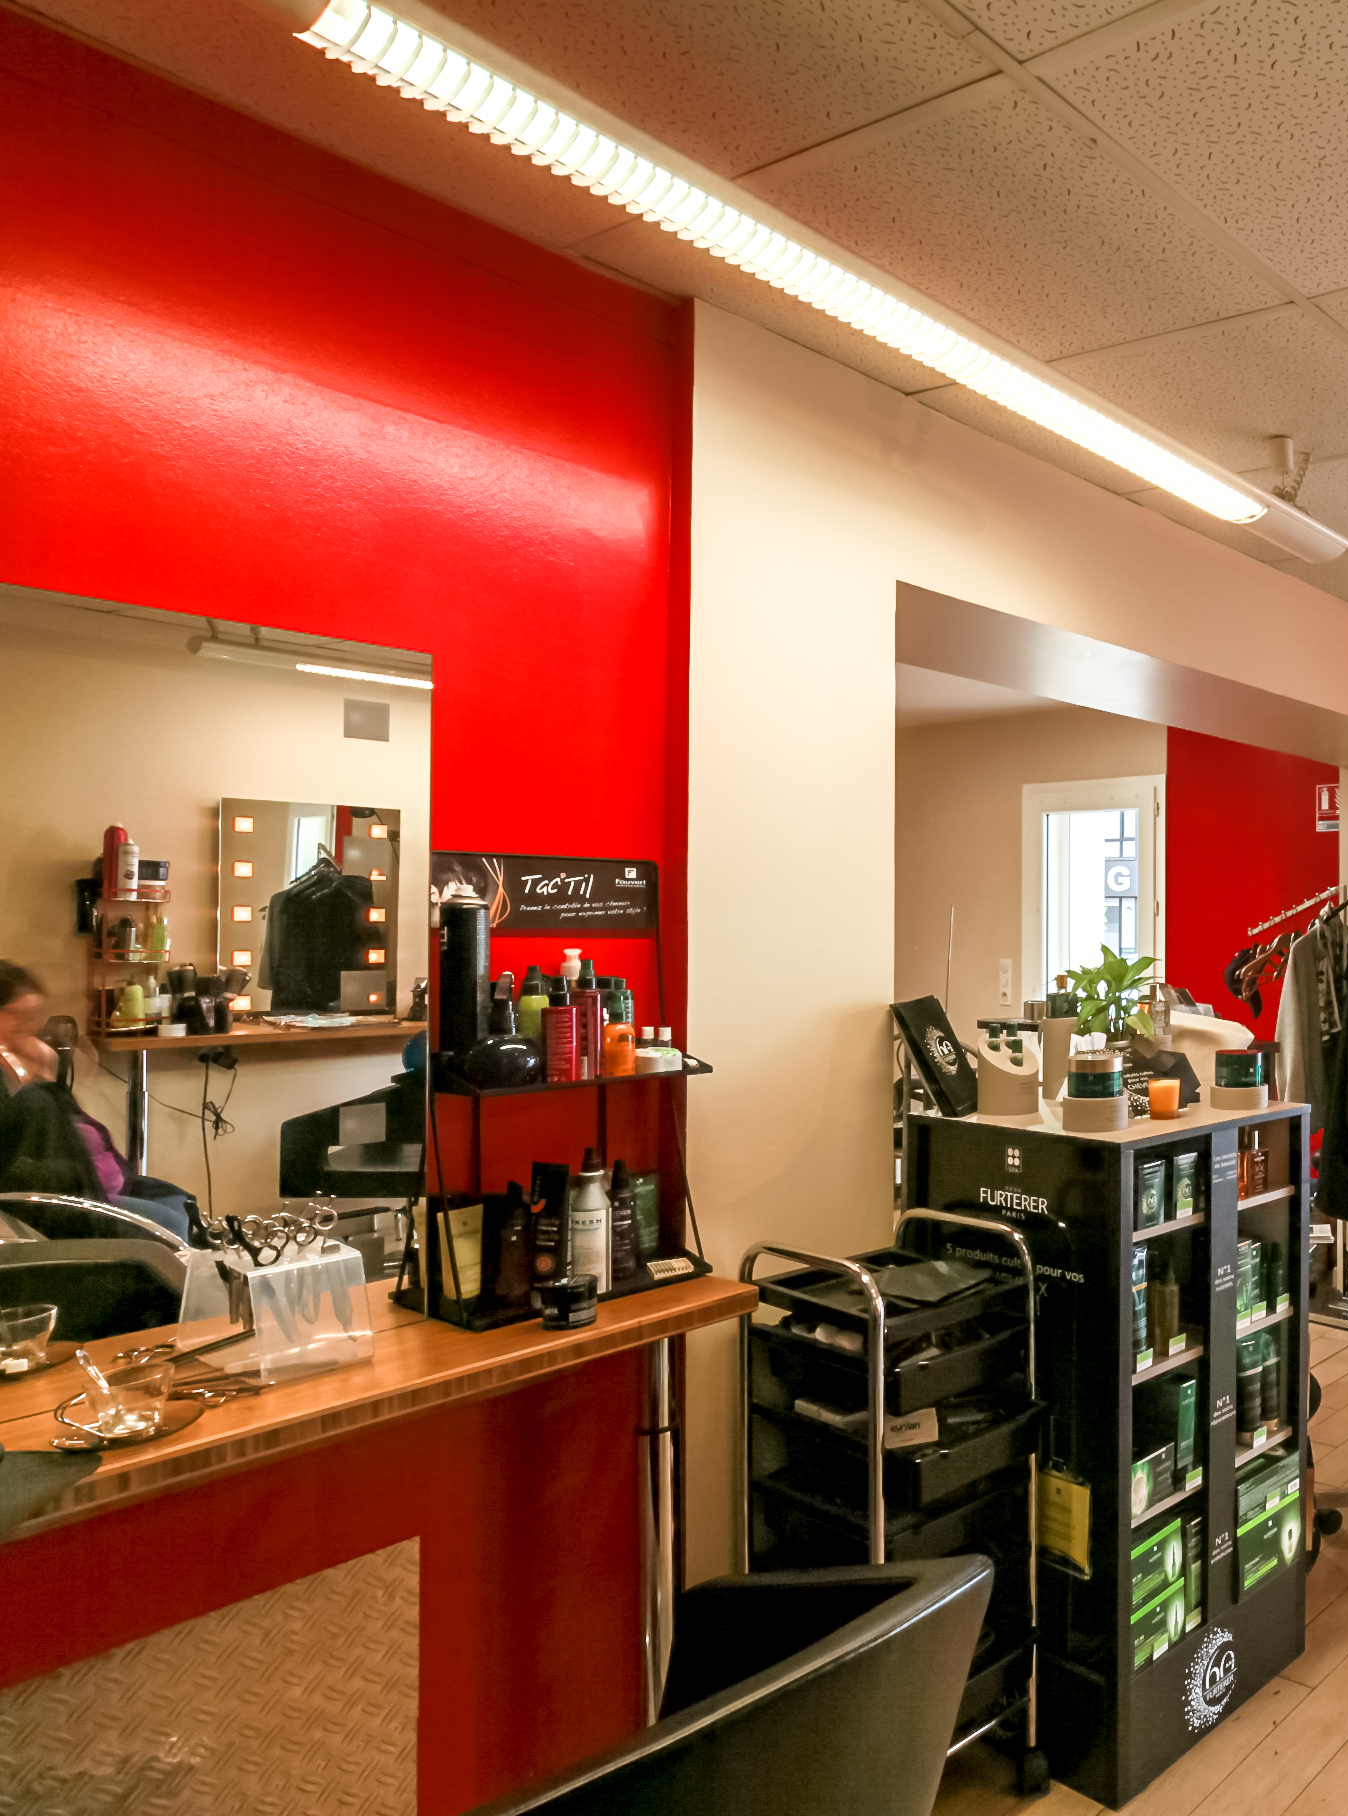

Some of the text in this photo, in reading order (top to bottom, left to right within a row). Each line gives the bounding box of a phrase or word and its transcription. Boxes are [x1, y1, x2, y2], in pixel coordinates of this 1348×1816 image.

[1107, 865, 1131, 892] G
[979, 1187, 1048, 1215] FURTERER
[1001, 1209, 1026, 1221] PARIS
[946, 1243, 952, 1254] 5
[955, 1246, 1000, 1264] produits
[1001, 1255, 1023, 1270] cult
[1036, 1263, 1062, 1278] pour
[1064, 1270, 1086, 1284] vos
[1217, 1264, 1231, 1276] N°1
[1216, 1394, 1230, 1408] N°1
[1215, 1531, 1229, 1546] N°1
